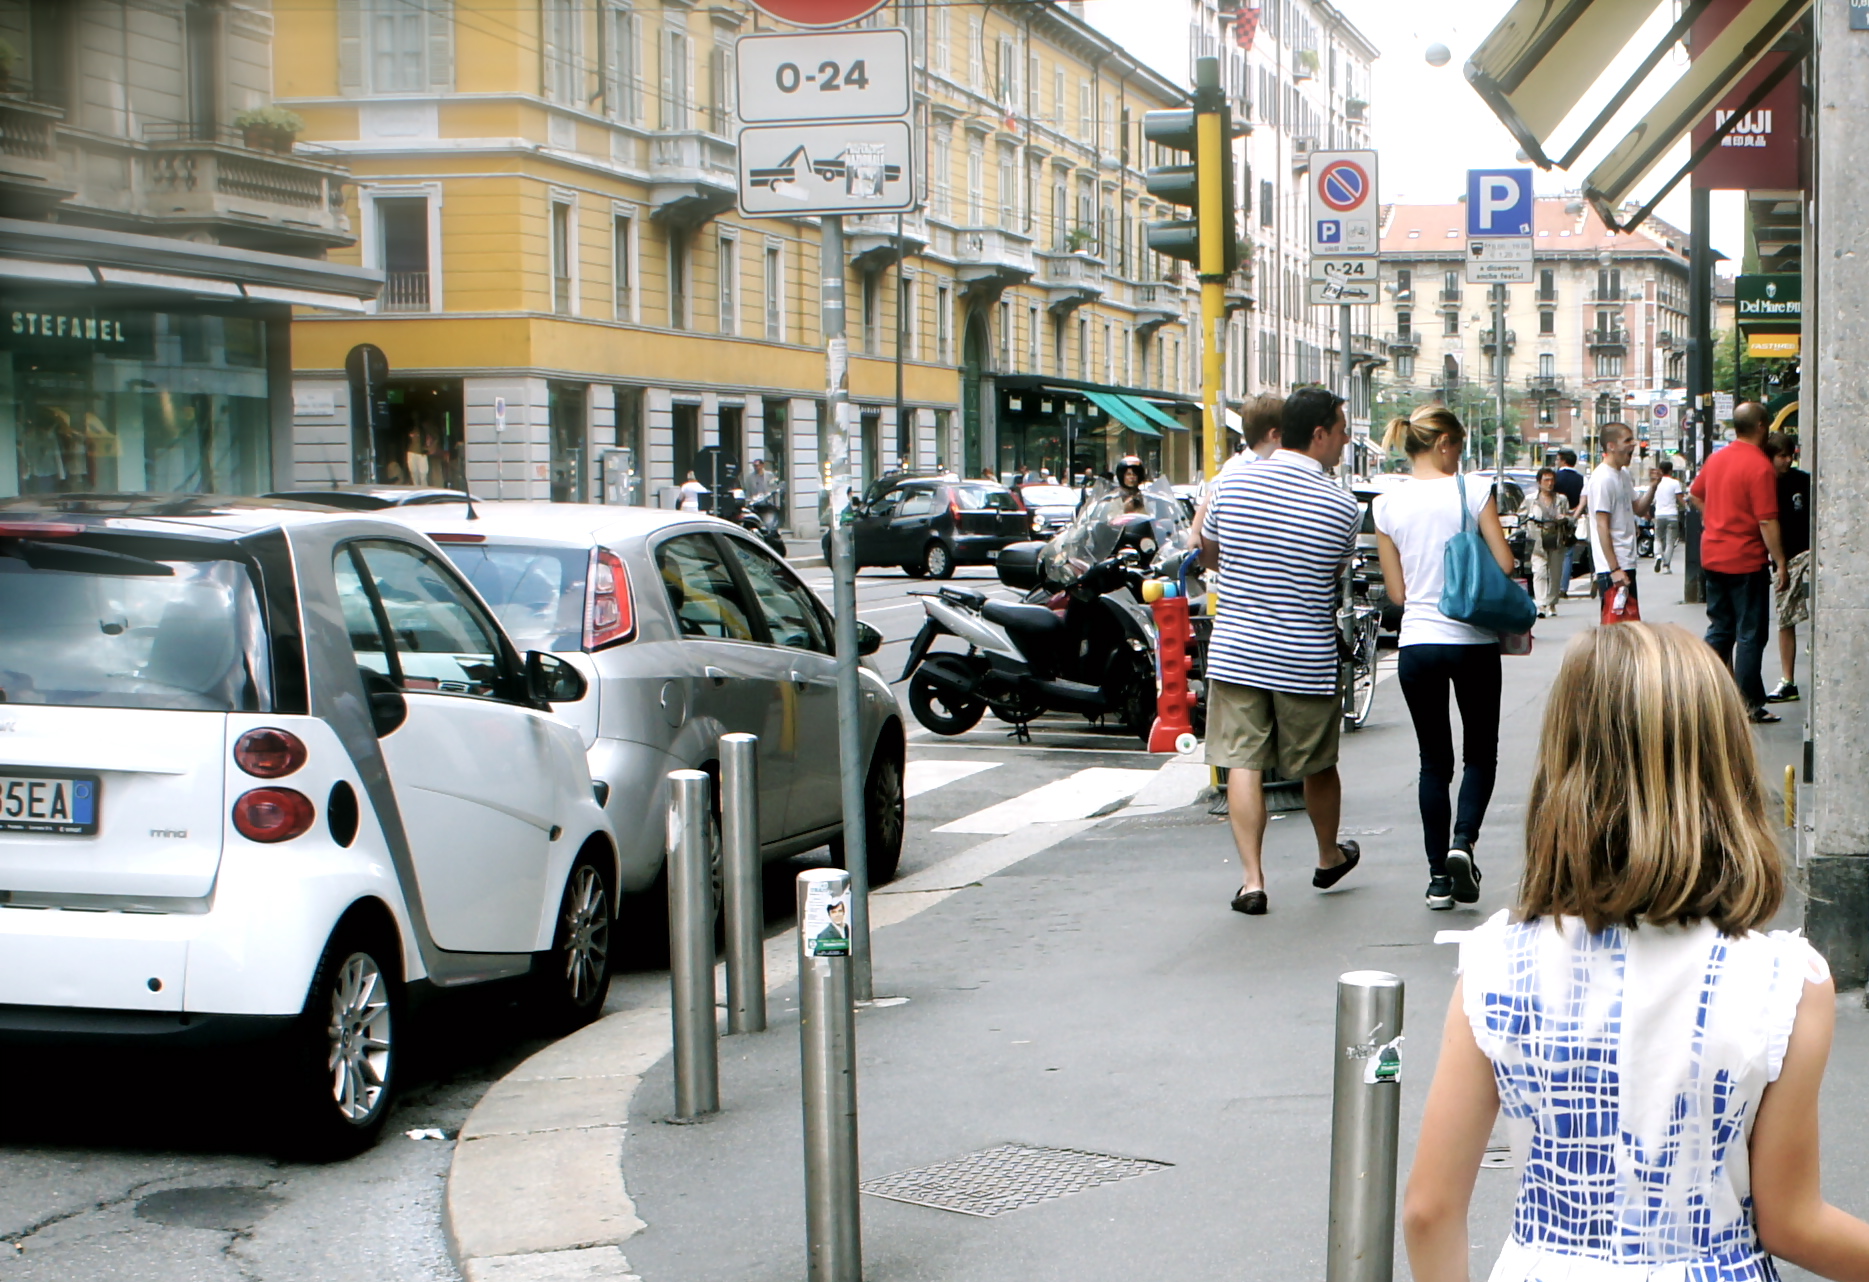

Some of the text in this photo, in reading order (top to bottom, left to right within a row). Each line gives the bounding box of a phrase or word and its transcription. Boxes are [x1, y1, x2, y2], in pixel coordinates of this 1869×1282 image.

[776, 60, 869, 93] 0-24
[1480, 176, 1519, 229] P
[1322, 222, 1336, 241] P
[1324, 262, 1365, 276] 0-24
[1740, 298, 1760, 313] Del
[1761, 300, 1786, 313] Mare
[12, 311, 125, 342] STEFANEL
[0, 781, 68, 819] 5EA
